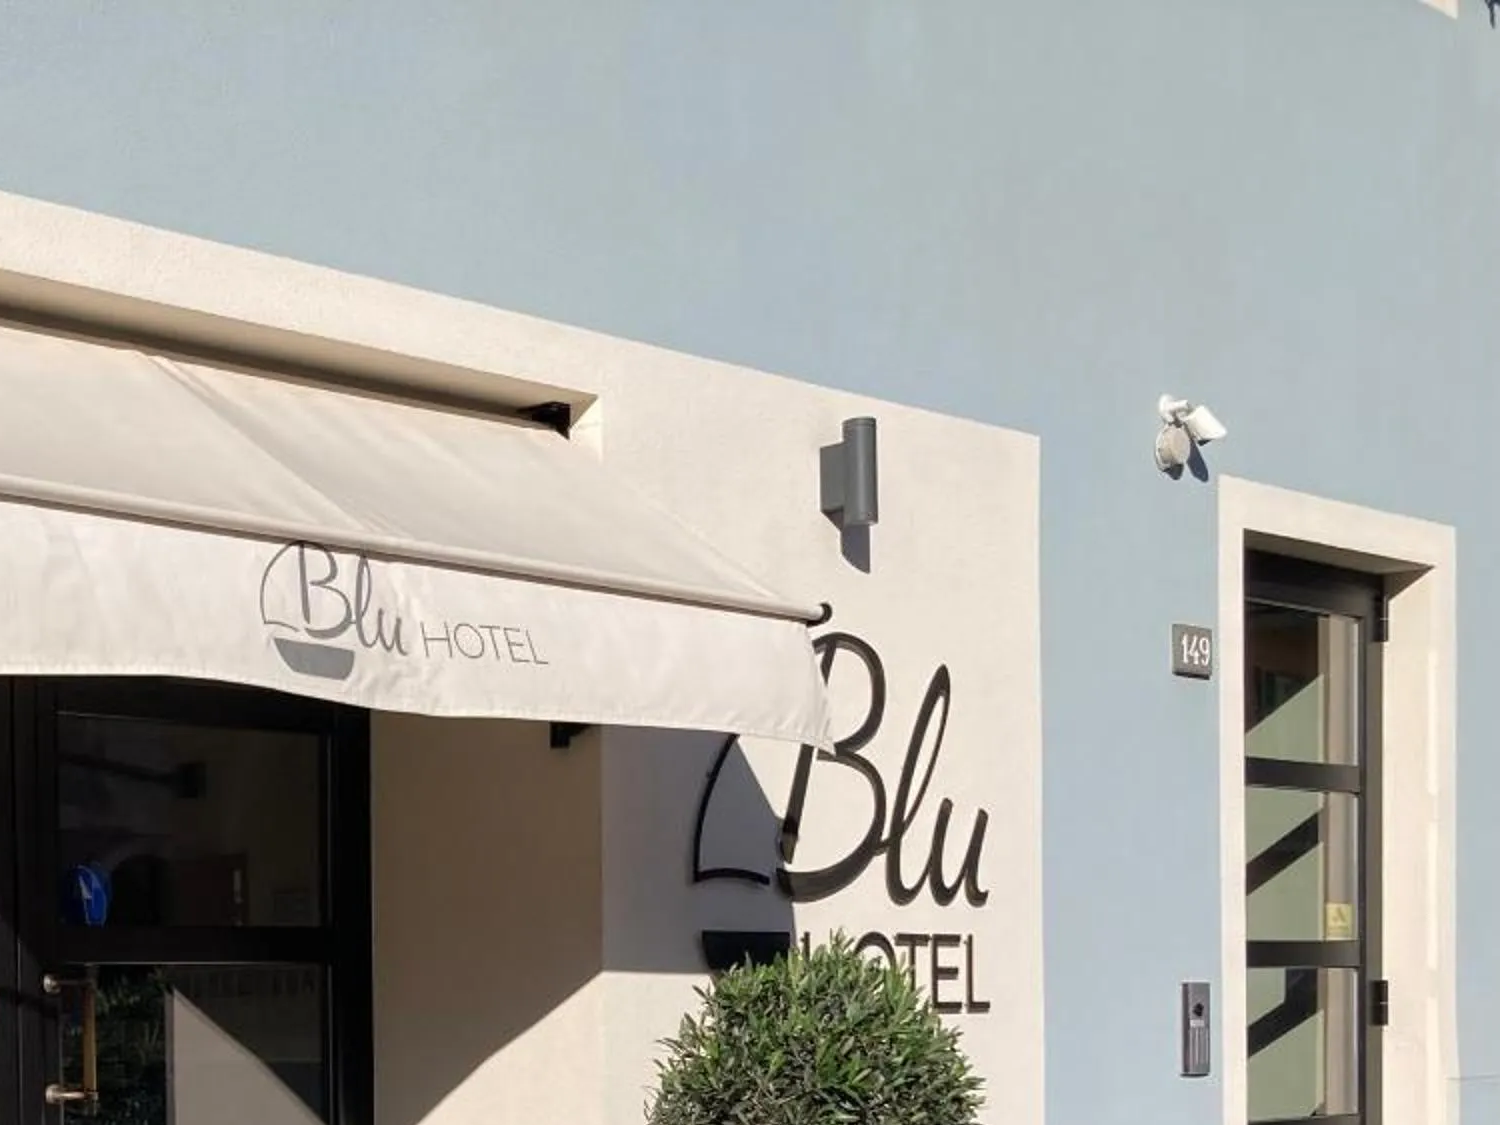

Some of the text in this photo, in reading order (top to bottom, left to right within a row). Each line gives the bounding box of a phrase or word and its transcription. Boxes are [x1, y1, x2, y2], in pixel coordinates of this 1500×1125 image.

[296, 538, 549, 664] Blu HOTEL
[1181, 633, 1211, 667] 149
[774, 630, 990, 908] Blu
[803, 931, 991, 1013] TEL
